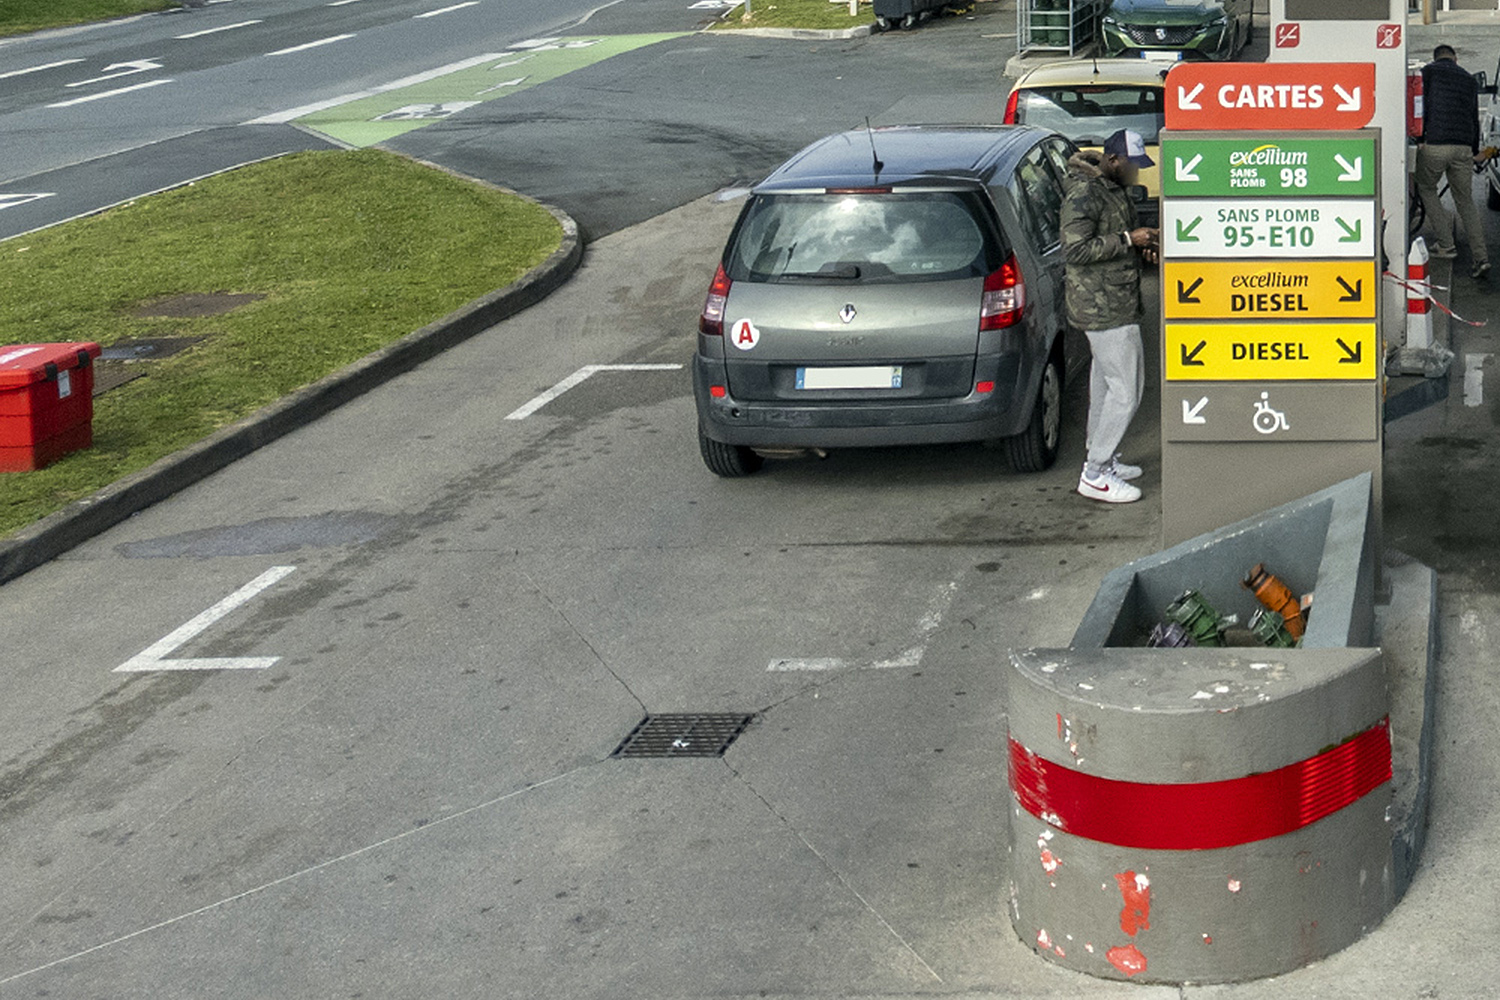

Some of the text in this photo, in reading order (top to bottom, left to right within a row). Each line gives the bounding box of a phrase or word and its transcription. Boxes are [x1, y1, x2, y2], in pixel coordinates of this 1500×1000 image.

[1217, 84, 1324, 109] CARTES
[1230, 146, 1308, 166] excellium
[1230, 168, 1308, 188] SANS 98
[1230, 178, 1266, 188] PLOMB
[1217, 208, 1320, 223] SANS PLOMB
[1223, 226, 1315, 248] 95-E10
[1230, 271, 1309, 289] excellium
[1230, 293, 1309, 312] DIESEL
[737, 321, 755, 345] A
[1231, 342, 1309, 360] DIESEL
